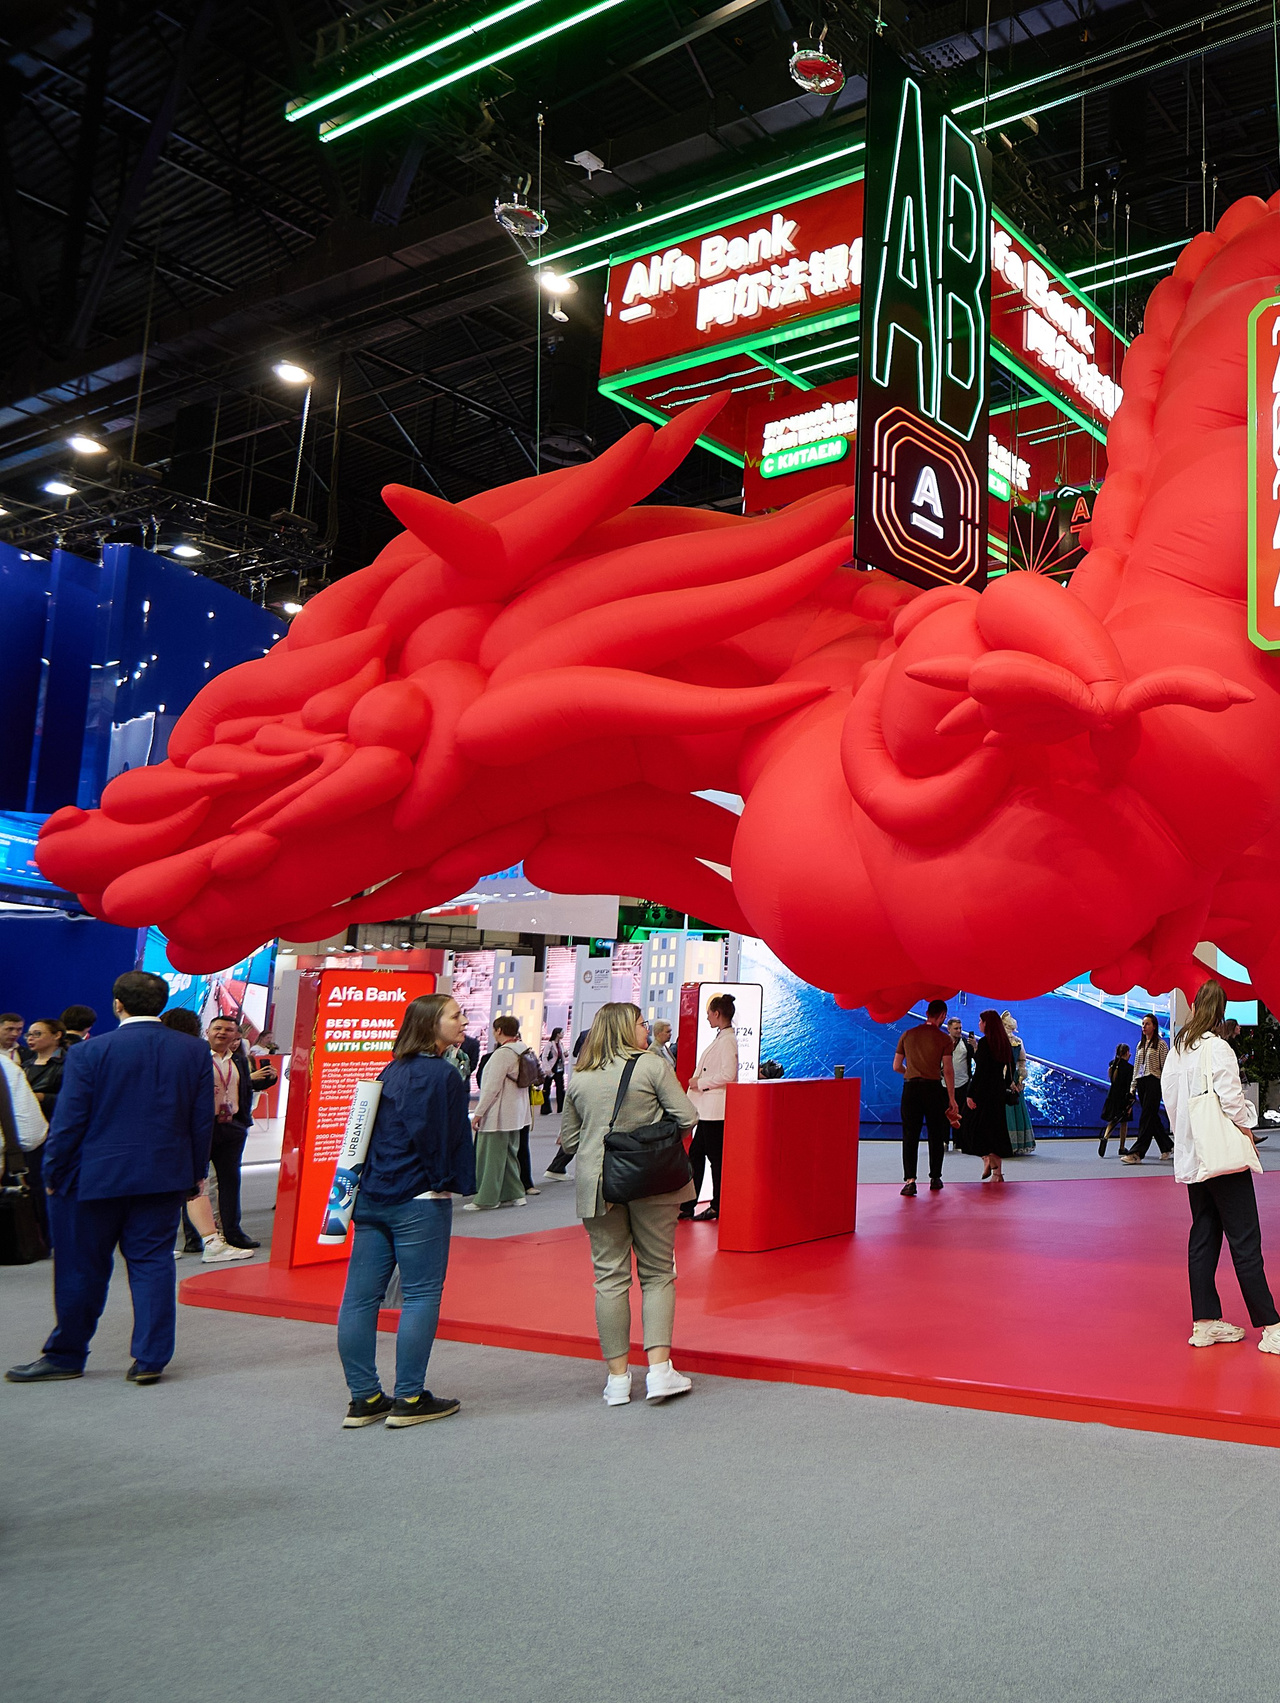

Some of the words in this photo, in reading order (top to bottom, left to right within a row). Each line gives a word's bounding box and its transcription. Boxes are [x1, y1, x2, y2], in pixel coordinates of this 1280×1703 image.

[622, 247, 697, 305] Alfa
[699, 213, 798, 280] Bank
[871, 77, 987, 441] AB
[1027, 259, 1095, 355] Bank
[777, 440, 842, 470] КИТАЕМ
[328, 986, 364, 1001] Alfa
[365, 987, 407, 1002] Bank
[325, 1019, 360, 1028] BEST
[361, 1019, 396, 1028] BANK
[325, 1030, 351, 1040] FOR
[352, 1030, 399, 1040] BUSINE
[327, 1041, 361, 1052] WITH
[362, 1041, 394, 1051] CHIN
